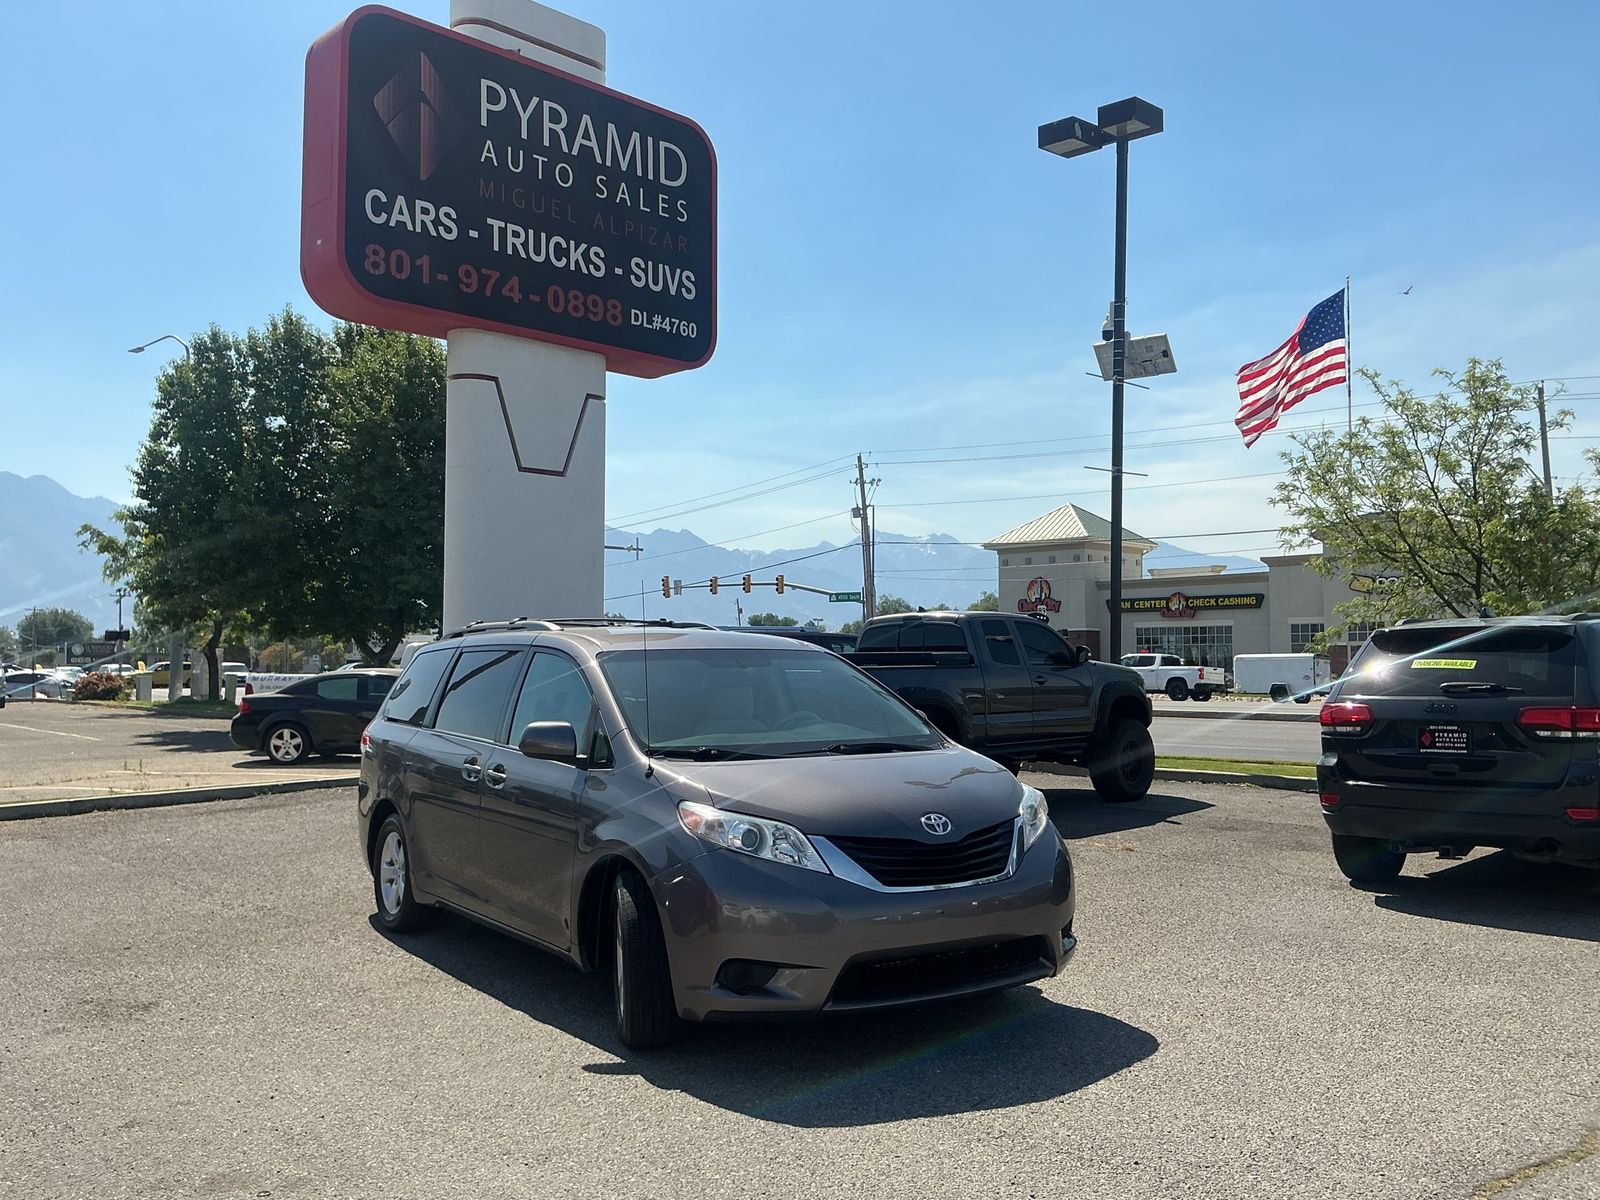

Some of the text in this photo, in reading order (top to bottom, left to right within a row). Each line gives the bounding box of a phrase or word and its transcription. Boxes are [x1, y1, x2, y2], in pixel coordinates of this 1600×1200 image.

[480, 78, 688, 187] PYRAMID
[479, 178, 688, 254] MIGUEL ALPIZAR
[480, 139, 688, 222] AUTO SALES
[364, 188, 459, 241] CARS
[486, 217, 606, 278] TRUCKS
[630, 257, 697, 300] SUVS
[631, 308, 697, 338] DL#4760
[1120, 596, 1256, 609] AN CENTER CHECK CASHING
[1443, 660, 1473, 668] AVAILABLE
